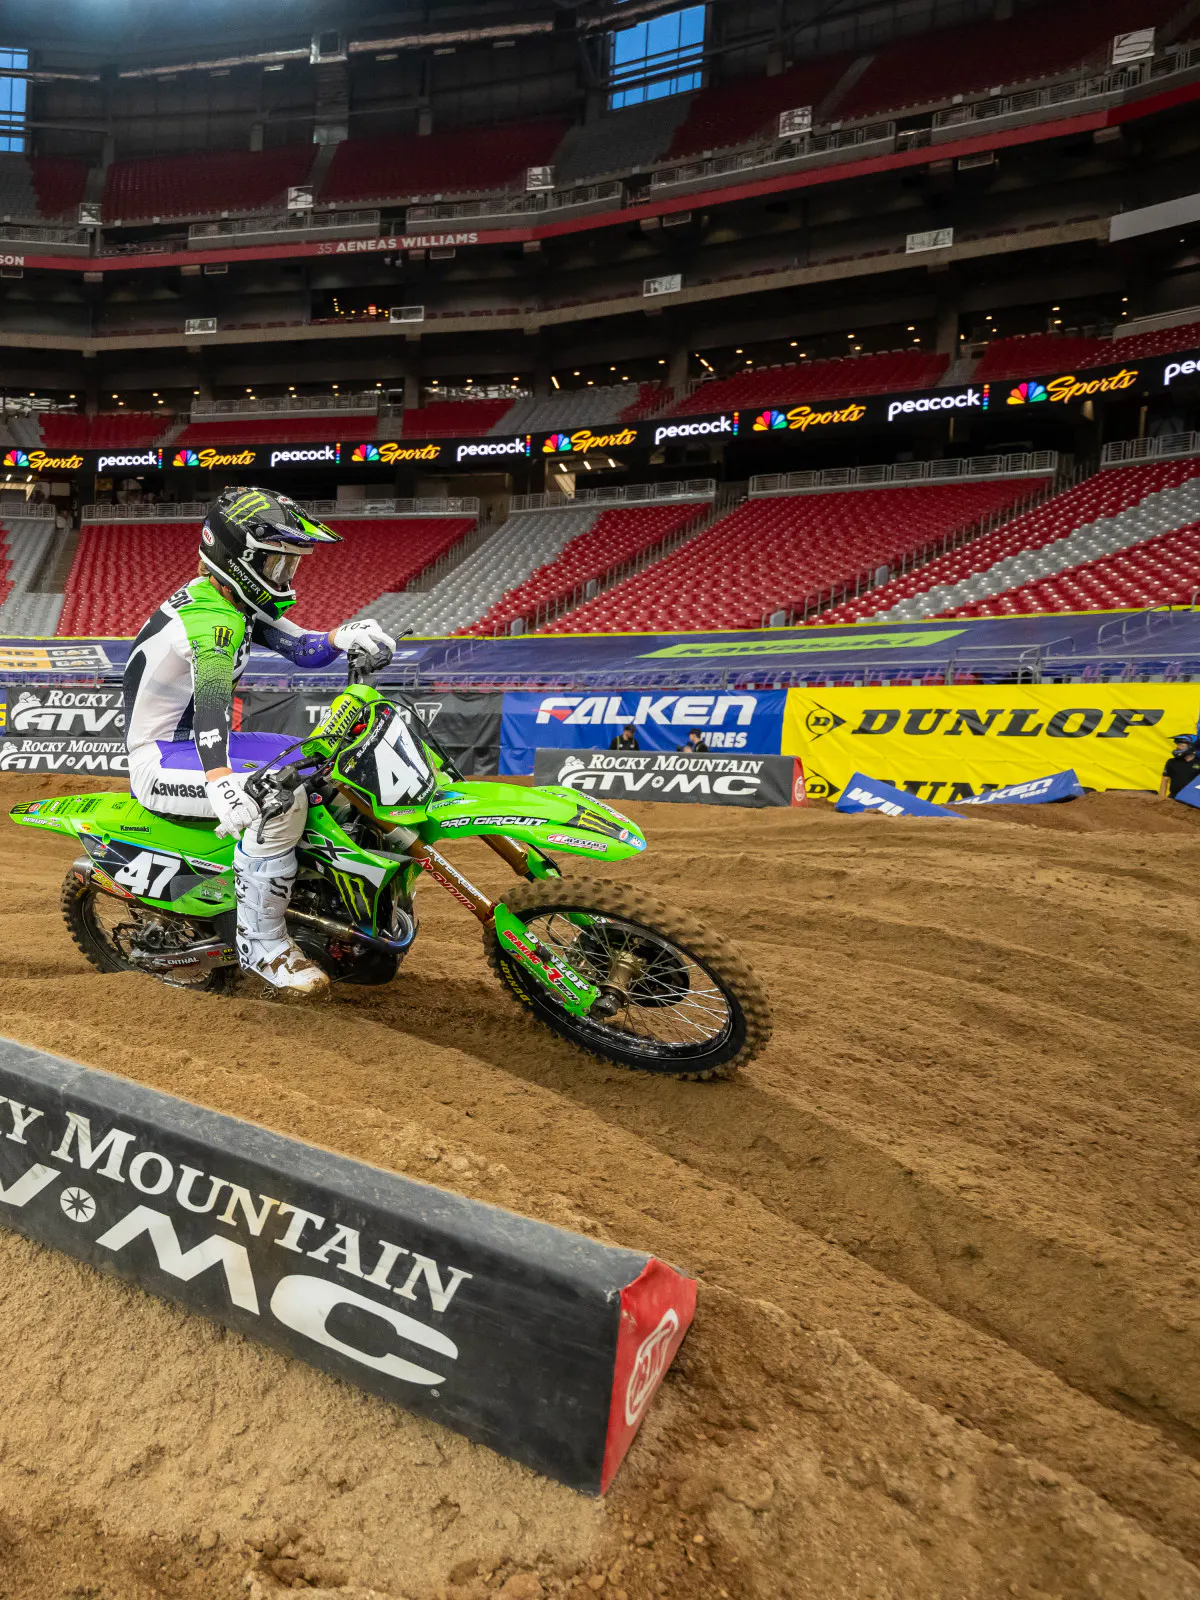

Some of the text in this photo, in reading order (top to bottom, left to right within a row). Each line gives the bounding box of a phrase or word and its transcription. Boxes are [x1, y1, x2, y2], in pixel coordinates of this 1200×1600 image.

[317, 232, 479, 254] 35 AENEAS WILLIAMS
[1046, 368, 1139, 404] Sports
[888, 388, 981, 421] peacock
[786, 403, 867, 432] Sports
[570, 428, 638, 454] Sports
[655, 415, 732, 445] peacock
[28, 450, 84, 471] Sports
[98, 451, 157, 471] peacock
[198, 448, 256, 470] Sports
[270, 445, 335, 467] peacock
[378, 442, 441, 465] Sports
[456, 439, 525, 462] peacock
[51, 649, 98, 657] CAT
[45, 690, 114, 708] ROCKY
[536, 696, 757, 725] FALKEN
[852, 708, 1165, 738] DUNLOP
[20, 740, 67, 752] ROCKY
[373, 712, 430, 806] 47
[590, 754, 765, 775] ROCKY MOUNTAIN
[217, 780, 243, 810] FOX
[440, 816, 550, 828] PRO CIRCUIT
[114, 851, 181, 899] 47
[502, 929, 542, 965] BRAKING
[50, 1109, 474, 1314] MOUNTAIN
